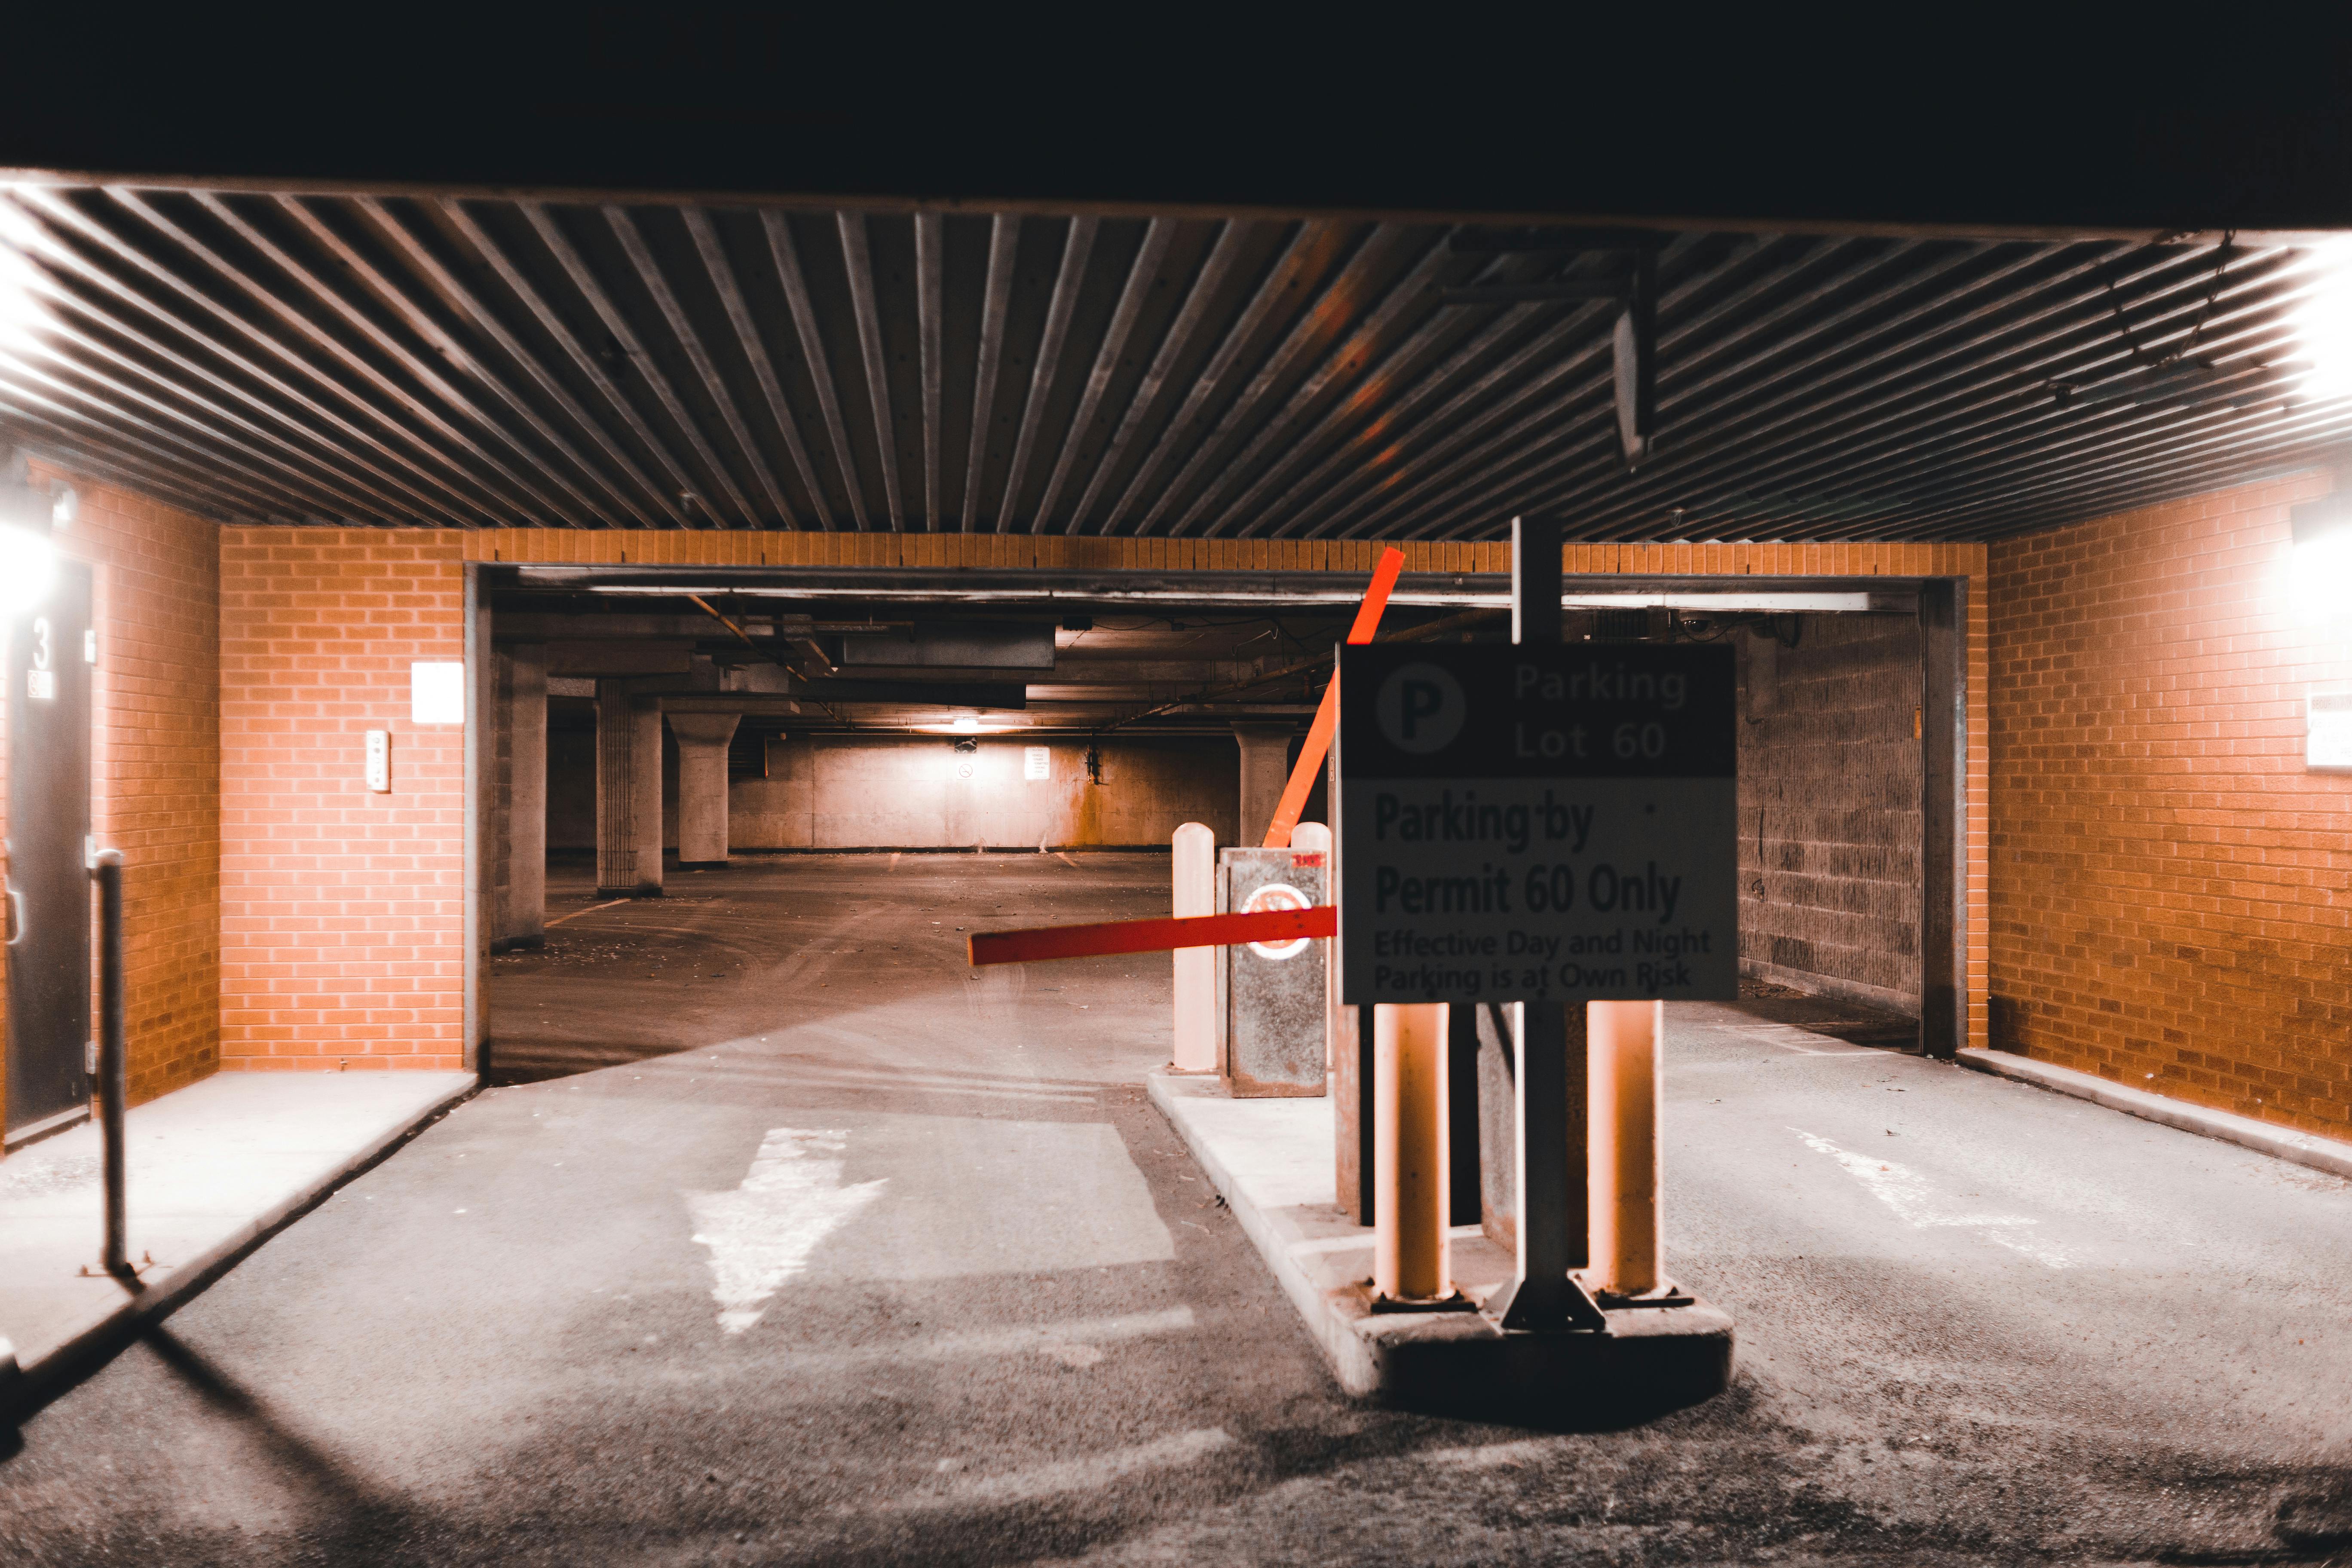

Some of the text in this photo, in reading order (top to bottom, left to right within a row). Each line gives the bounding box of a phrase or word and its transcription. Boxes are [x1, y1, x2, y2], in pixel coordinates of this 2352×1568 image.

[33, 617, 49, 669] 3
[1402, 680, 1443, 740] P
[1515, 662, 1687, 710] Parking
[1515, 722, 1665, 760] Lot 60
[1375, 789, 1594, 854] Parking by
[1375, 861, 1681, 925] Permit 60 Only
[1374, 927, 1711, 961] Effective Day and Night
[1375, 962, 1691, 995] Parking is at Own Risk
